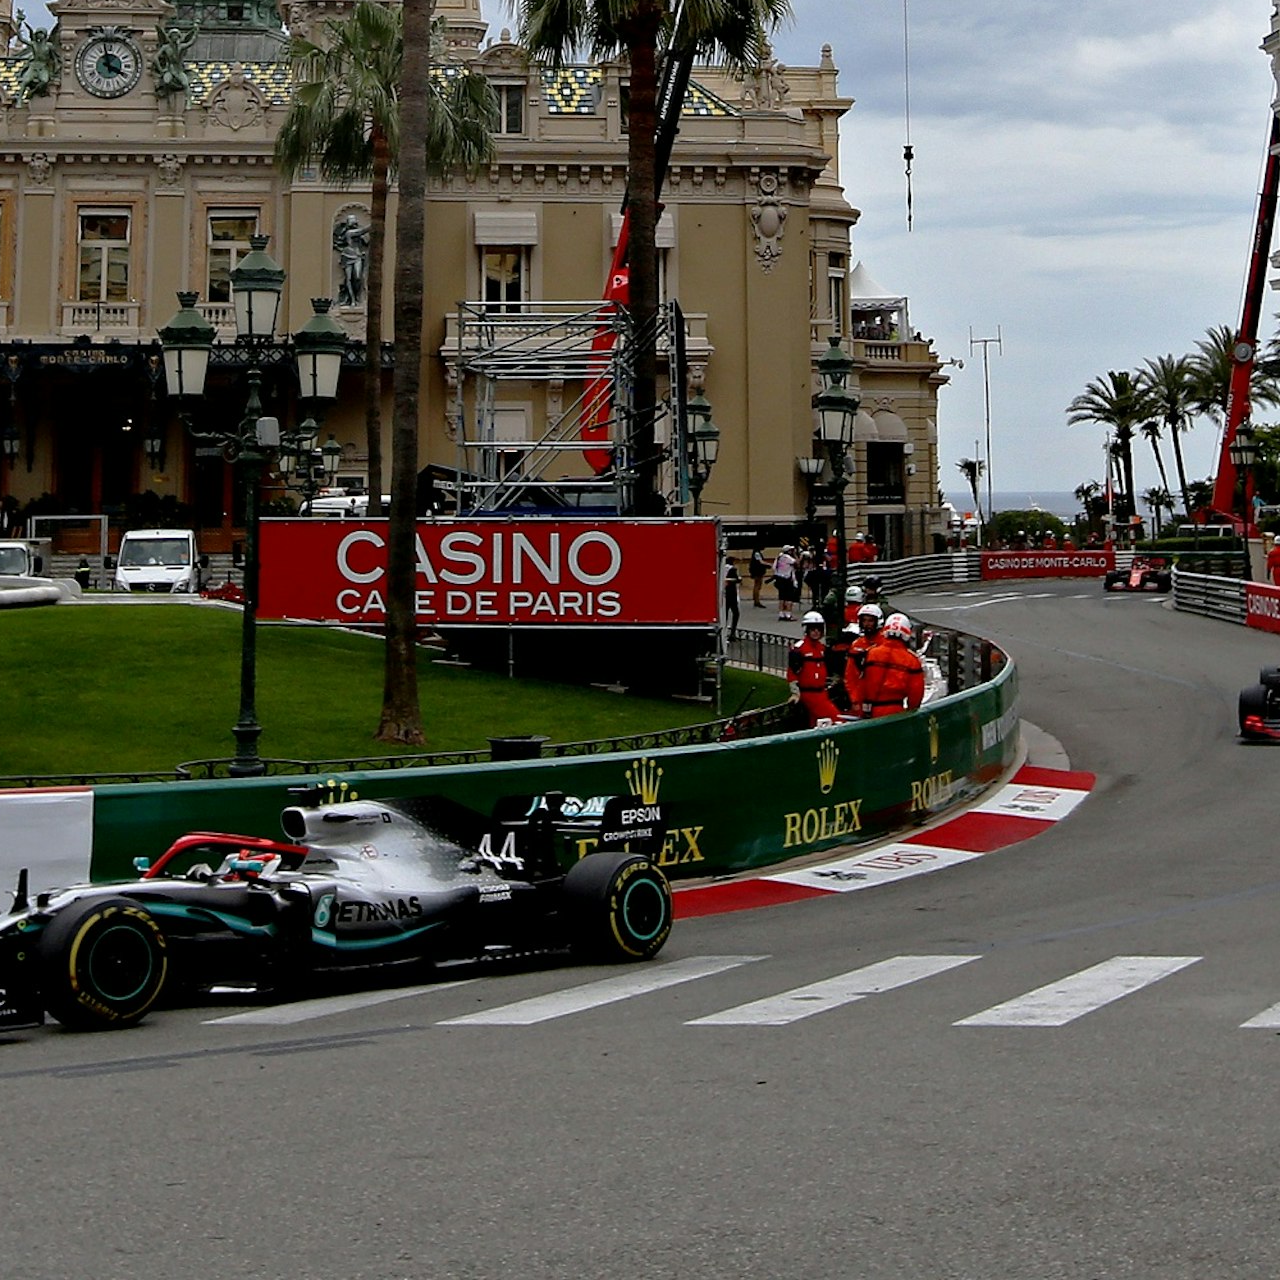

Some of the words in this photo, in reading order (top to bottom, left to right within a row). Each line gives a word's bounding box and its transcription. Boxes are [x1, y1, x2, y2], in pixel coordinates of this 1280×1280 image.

[668, 61, 680, 83] LEVAGE
[988, 557, 1020, 569] CASINO
[1021, 558, 1035, 568] DE
[1035, 556, 1107, 568] MONTE-CARLO
[336, 589, 436, 615] CAE
[446, 591, 499, 615] DE
[509, 591, 622, 617] PARIS
[1247, 593, 1271, 616] CASINO
[911, 770, 954, 812] ROLEX
[621, 807, 661, 824] EPSON
[783, 799, 863, 848] ROLEX
[478, 831, 525, 870] 44
[853, 850, 938, 870] UBS
[615, 862, 649, 891] ZERO
[123, 906, 166, 948] ZERO
